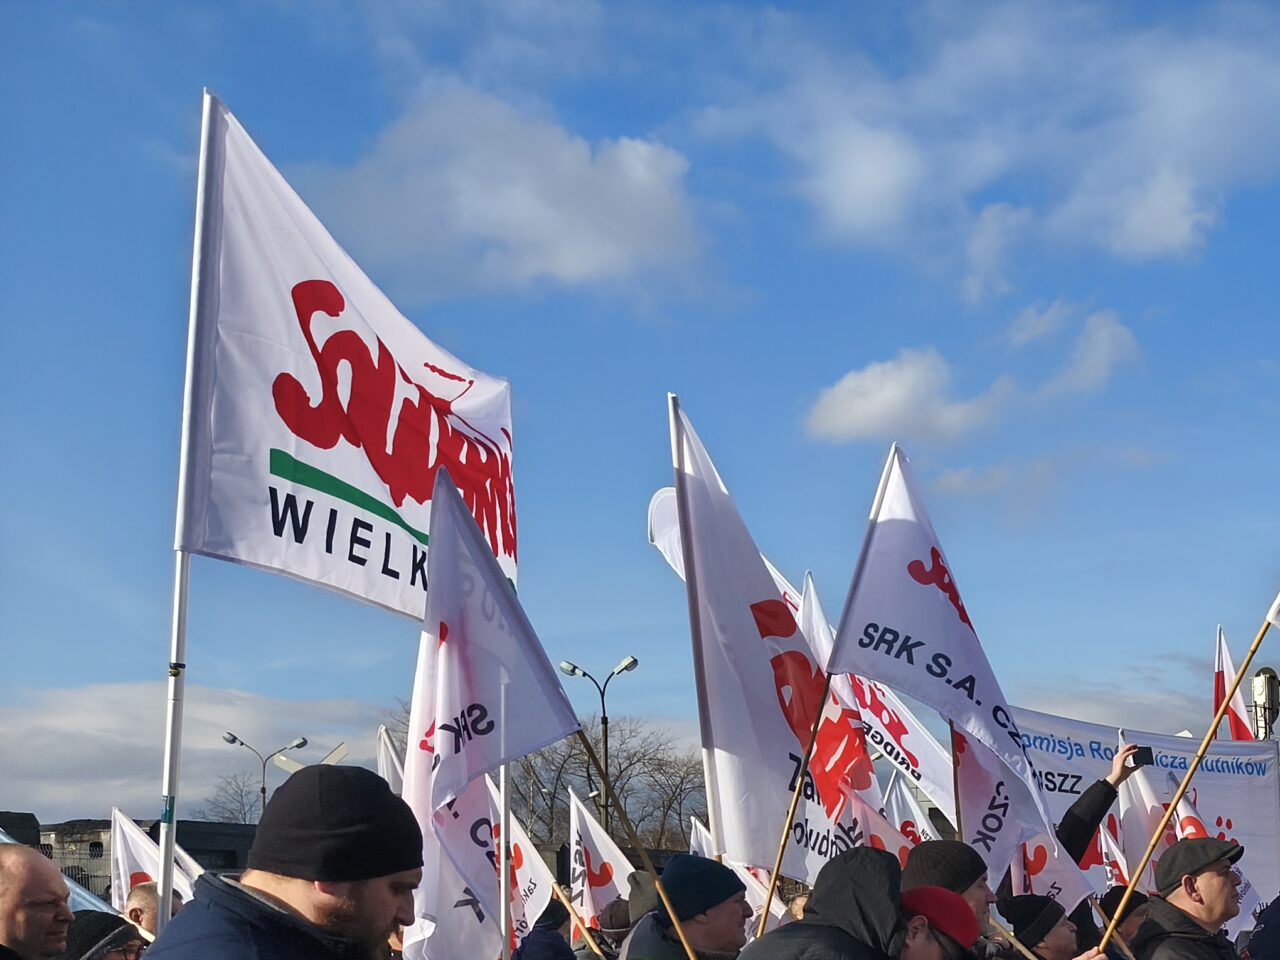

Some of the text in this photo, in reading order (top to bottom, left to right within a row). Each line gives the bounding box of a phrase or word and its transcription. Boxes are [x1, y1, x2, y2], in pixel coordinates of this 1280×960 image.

[858, 622, 925, 665] SRK
[925, 653, 981, 707] S.A.
[1022, 733, 1086, 760] omisja
